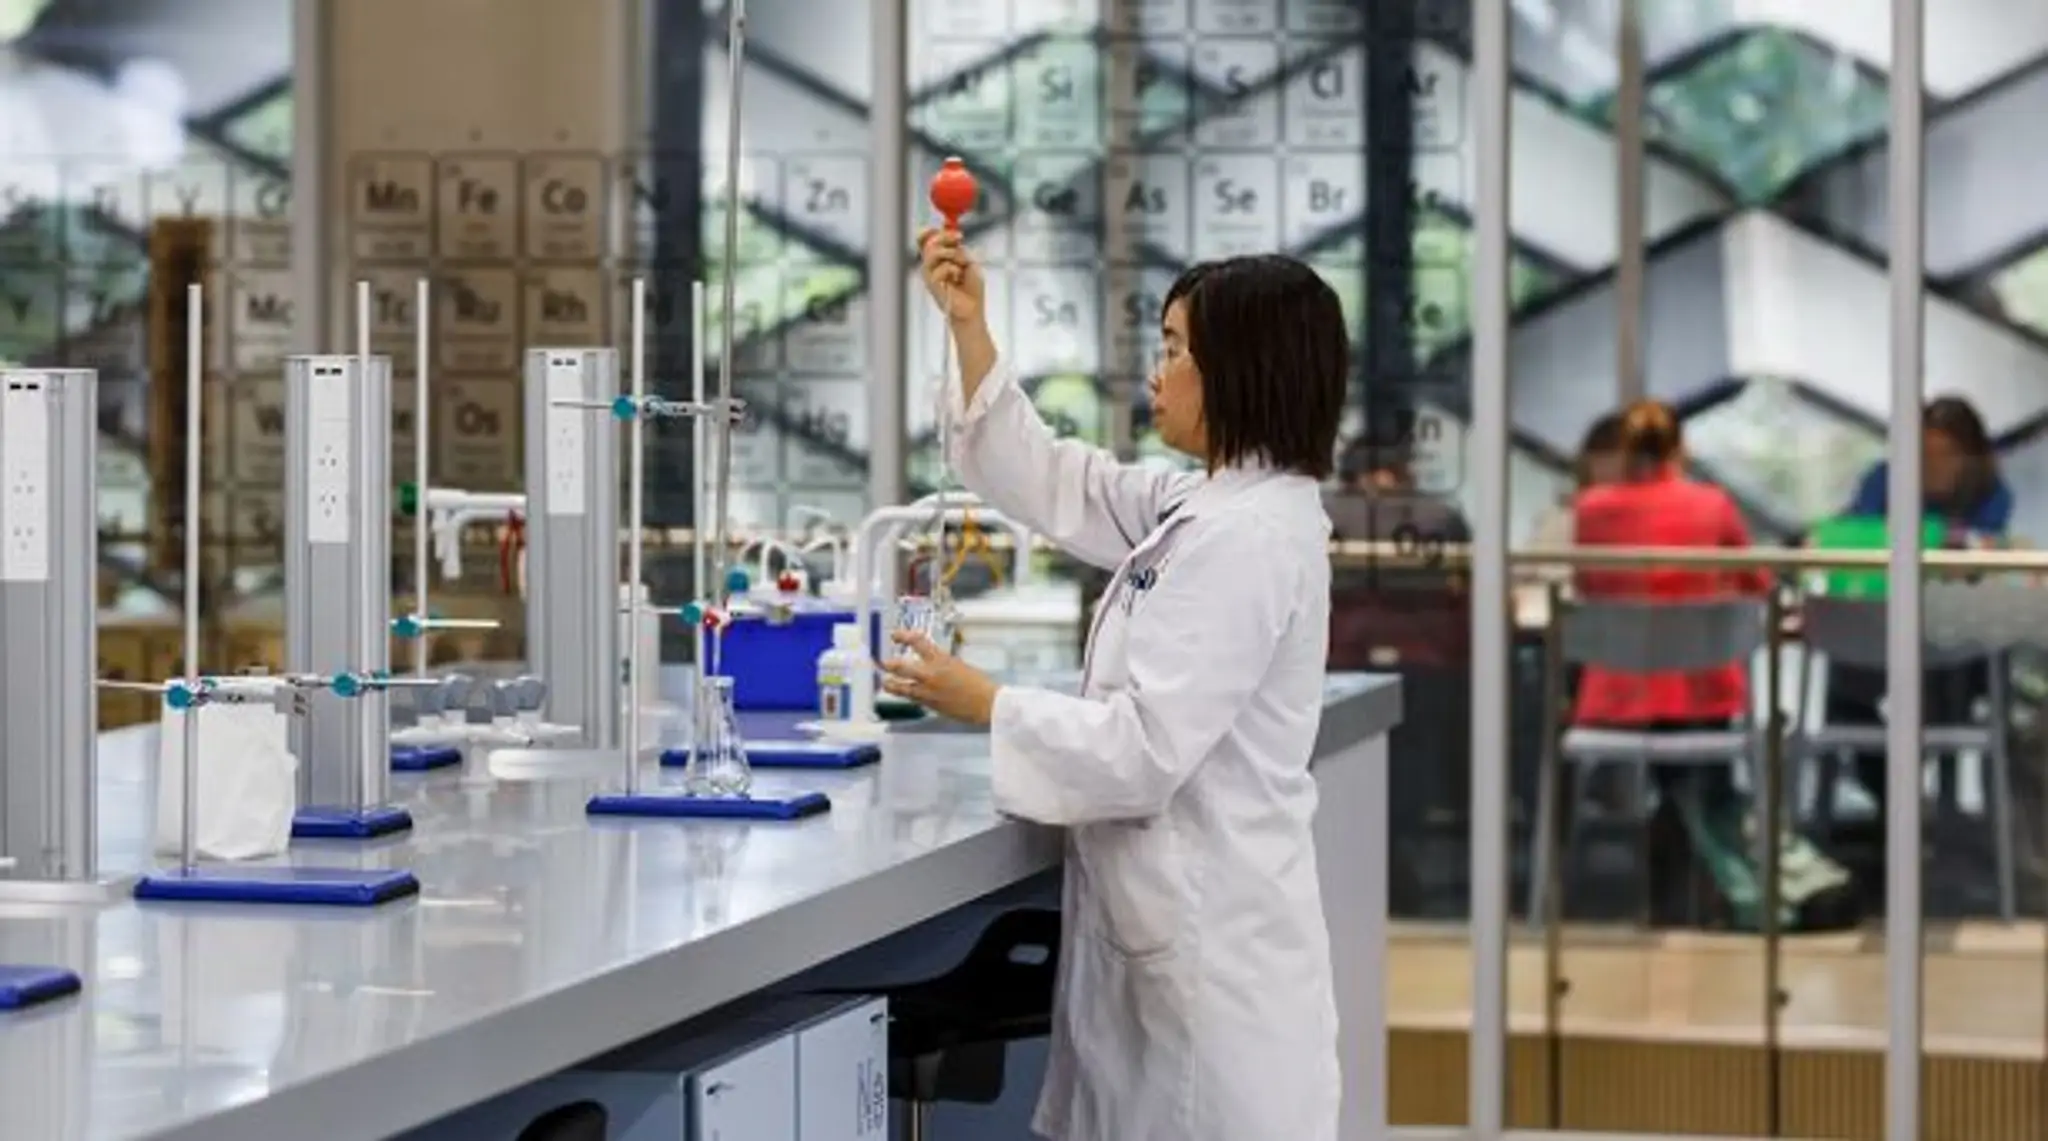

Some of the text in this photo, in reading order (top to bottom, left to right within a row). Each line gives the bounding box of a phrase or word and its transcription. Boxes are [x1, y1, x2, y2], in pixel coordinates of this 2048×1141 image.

[1038, 65, 1073, 103] Si
[1308, 64, 1343, 100] Cl
[366, 179, 420, 213] Mn
[457, 178, 499, 214] Fe
[540, 178, 588, 215] Co
[805, 180, 850, 213] Zn
[1124, 180, 1168, 214] As
[1213, 179, 1258, 214] Se
[1309, 181, 1344, 213] Br
[541, 289, 588, 322] Rh
[1035, 294, 1078, 328] Sn
[457, 402, 500, 435] Os
